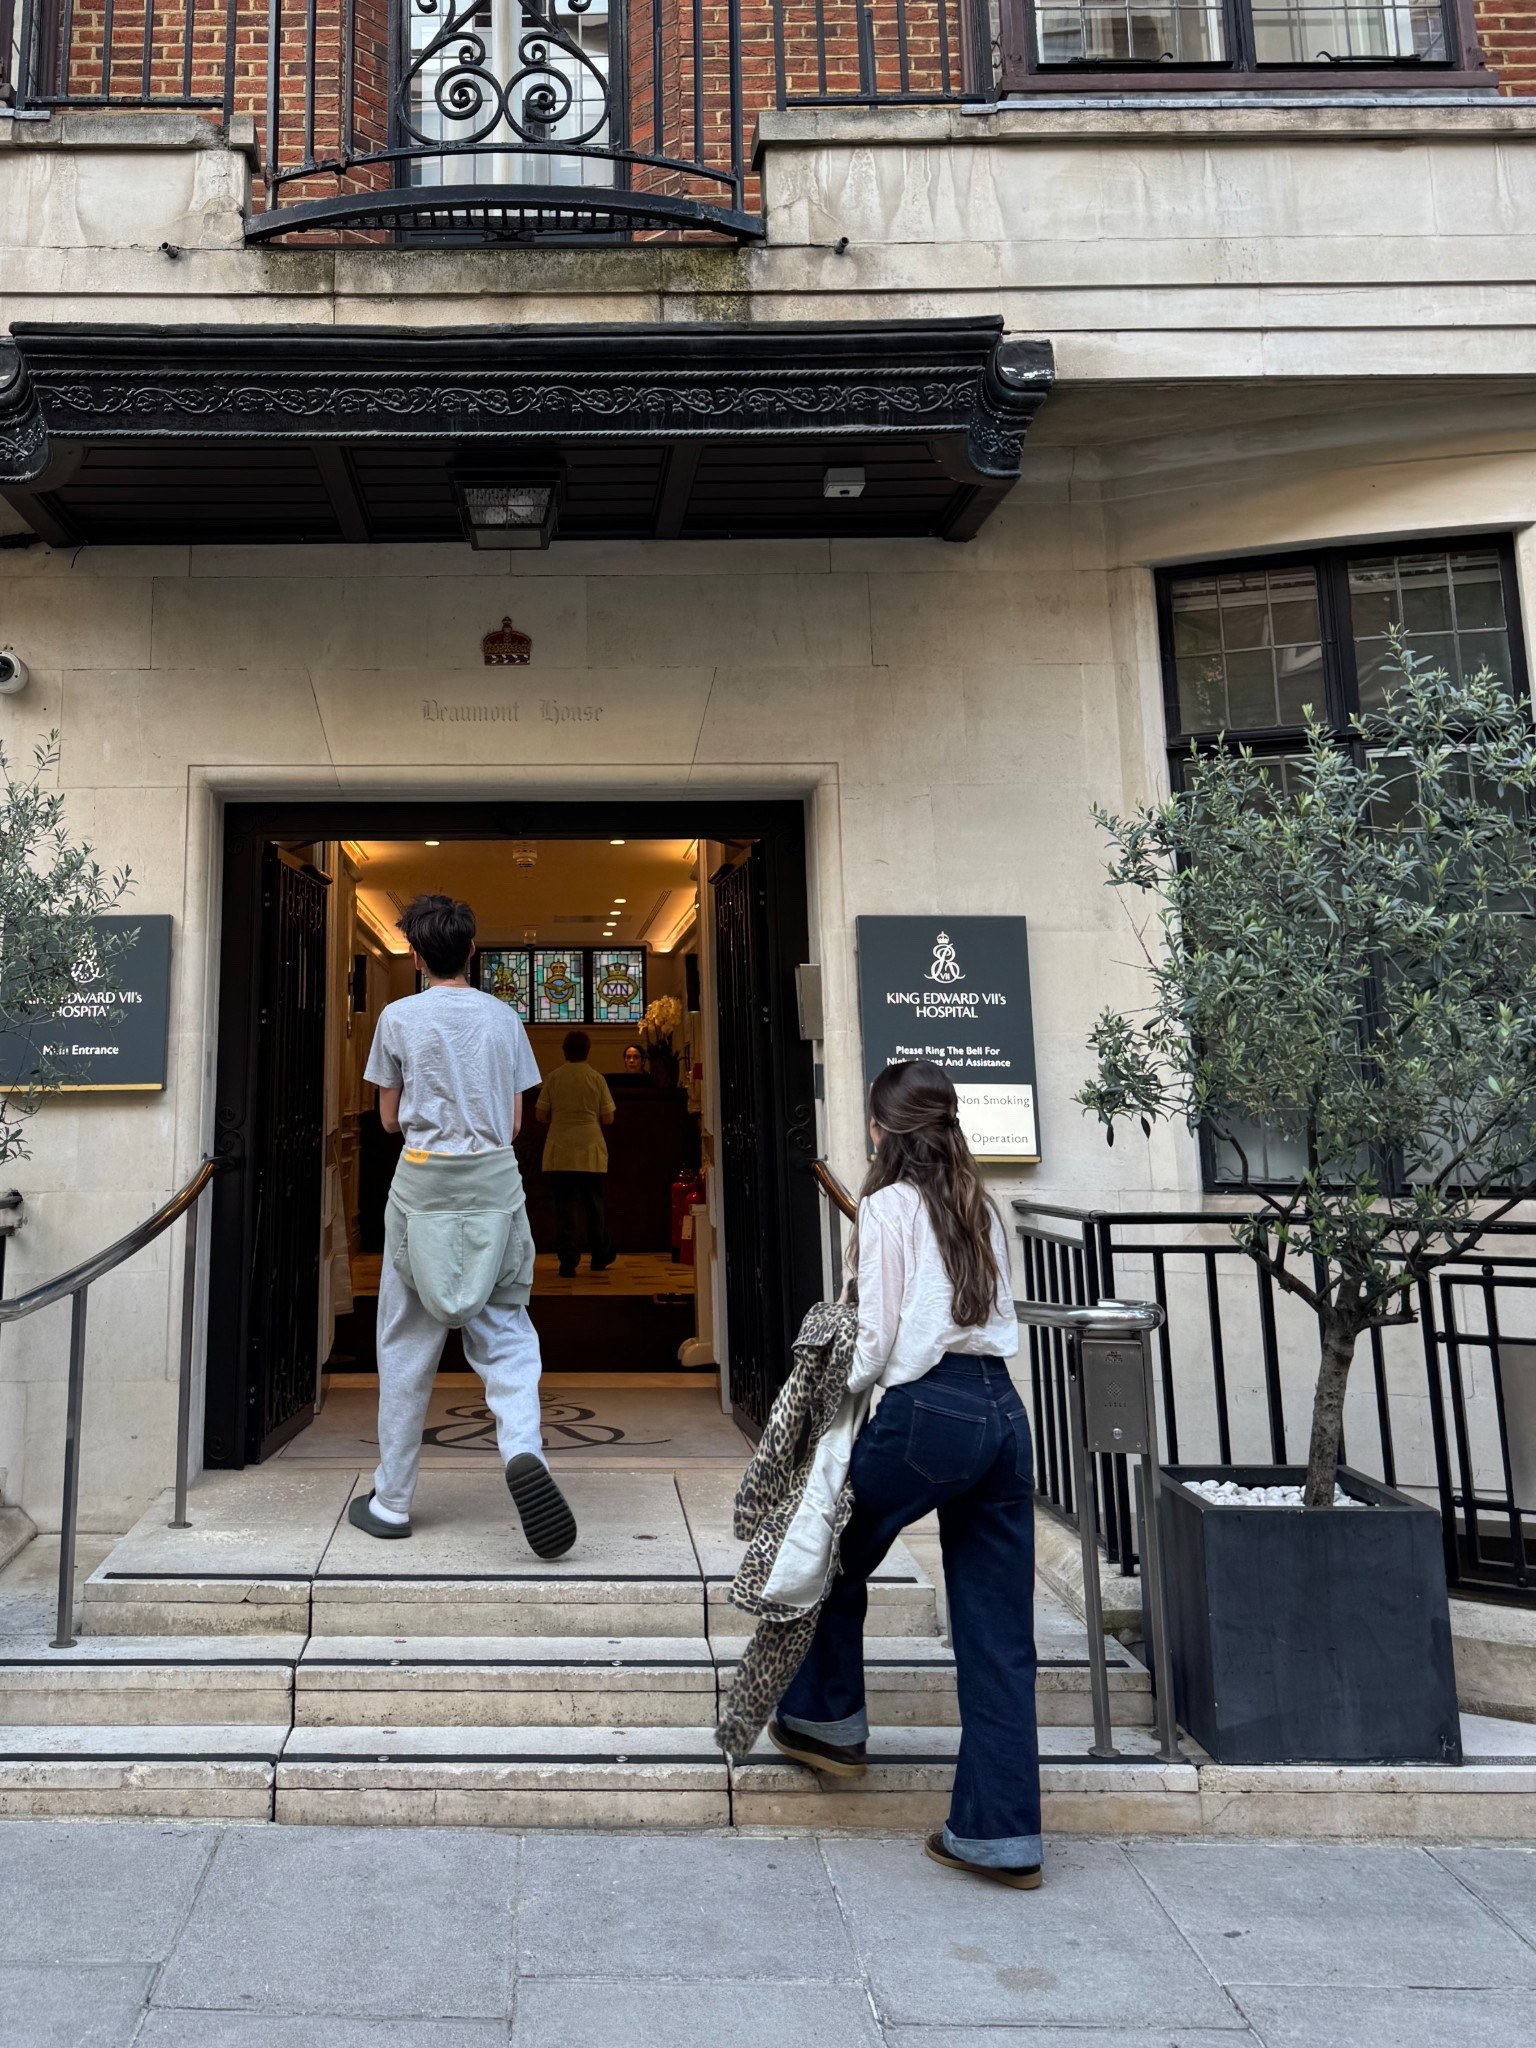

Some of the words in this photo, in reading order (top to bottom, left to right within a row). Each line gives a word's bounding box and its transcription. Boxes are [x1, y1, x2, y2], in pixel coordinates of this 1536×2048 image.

[422, 700, 520, 722] Beaumont
[539, 699, 604, 725] House
[606, 983, 629, 996] MN
[118, 992, 142, 1004] VII's
[886, 992, 920, 1005] KING
[923, 992, 980, 1005] EDWARD
[982, 993, 1007, 1006] VII's
[52, 1006, 110, 1018] HOSPITA
[916, 1006, 978, 1018] HOSPITAL
[71, 1045, 119, 1055] Entrance
[895, 1046, 923, 1055] Please
[925, 1046, 946, 1057] Ring
[946, 1047, 965, 1055] The
[966, 1047, 983, 1056] Bell
[984, 1047, 1001, 1056] For
[945, 1058, 963, 1067] And
[965, 1058, 1011, 1068] Assistance
[957, 1095, 980, 1105] Non
[983, 1094, 1030, 1109] Smoking
[971, 1133, 1029, 1146] Operation
